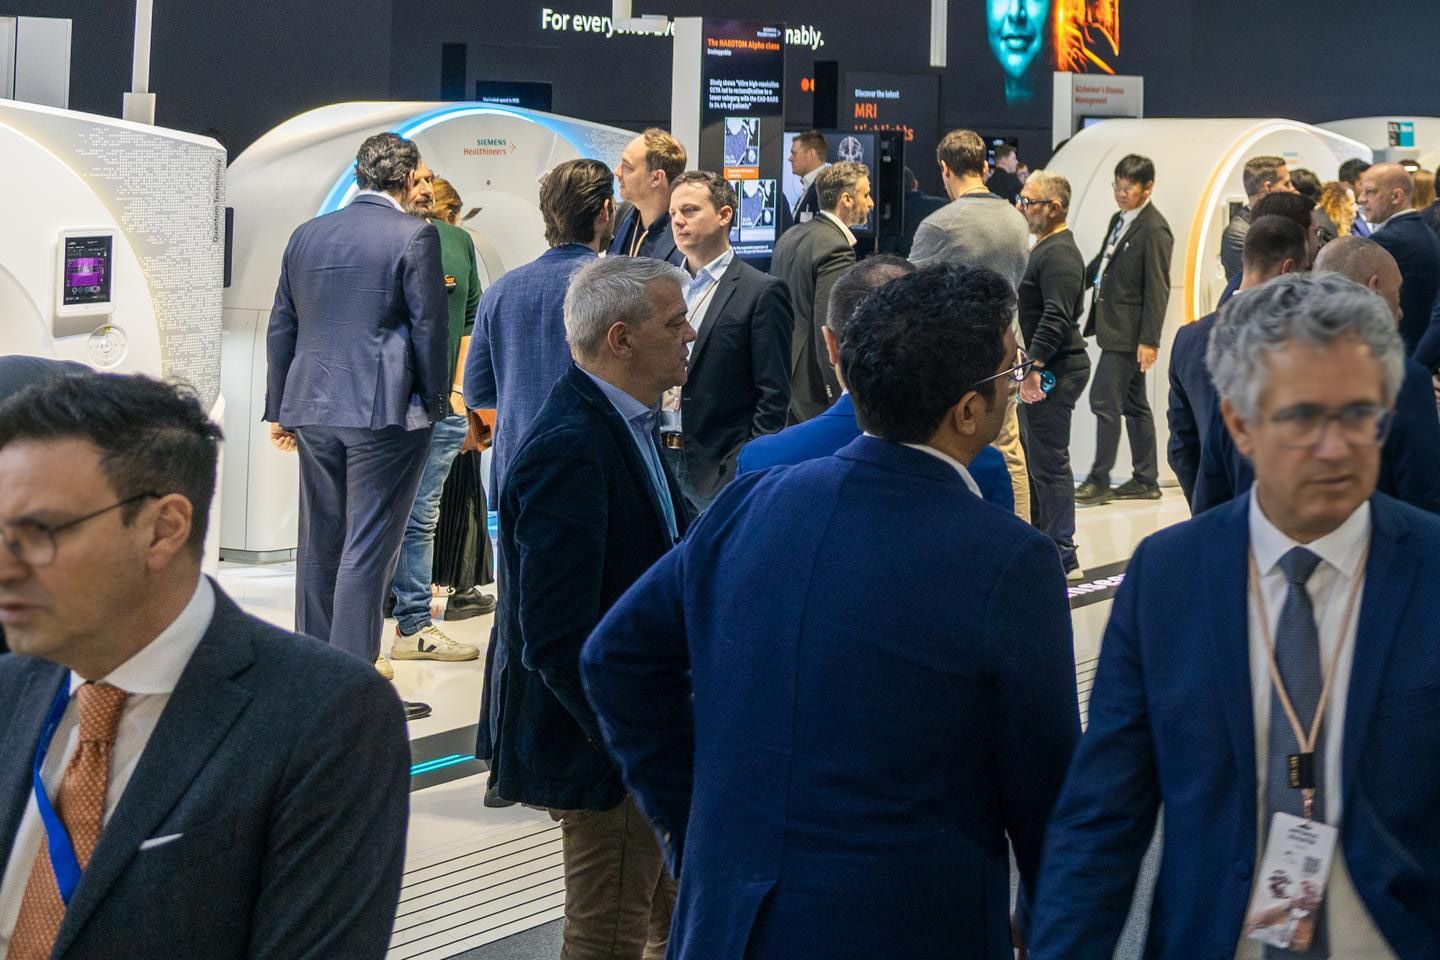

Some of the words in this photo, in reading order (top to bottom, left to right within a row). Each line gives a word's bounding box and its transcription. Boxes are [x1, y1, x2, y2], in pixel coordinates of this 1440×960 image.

[542, 8, 571, 31] For
[854, 88, 876, 98] Discover
[876, 89, 885, 98] the
[854, 103, 877, 118] MRI
[463, 147, 507, 155] Healthineers
[214, 158, 222, 203] Technology
